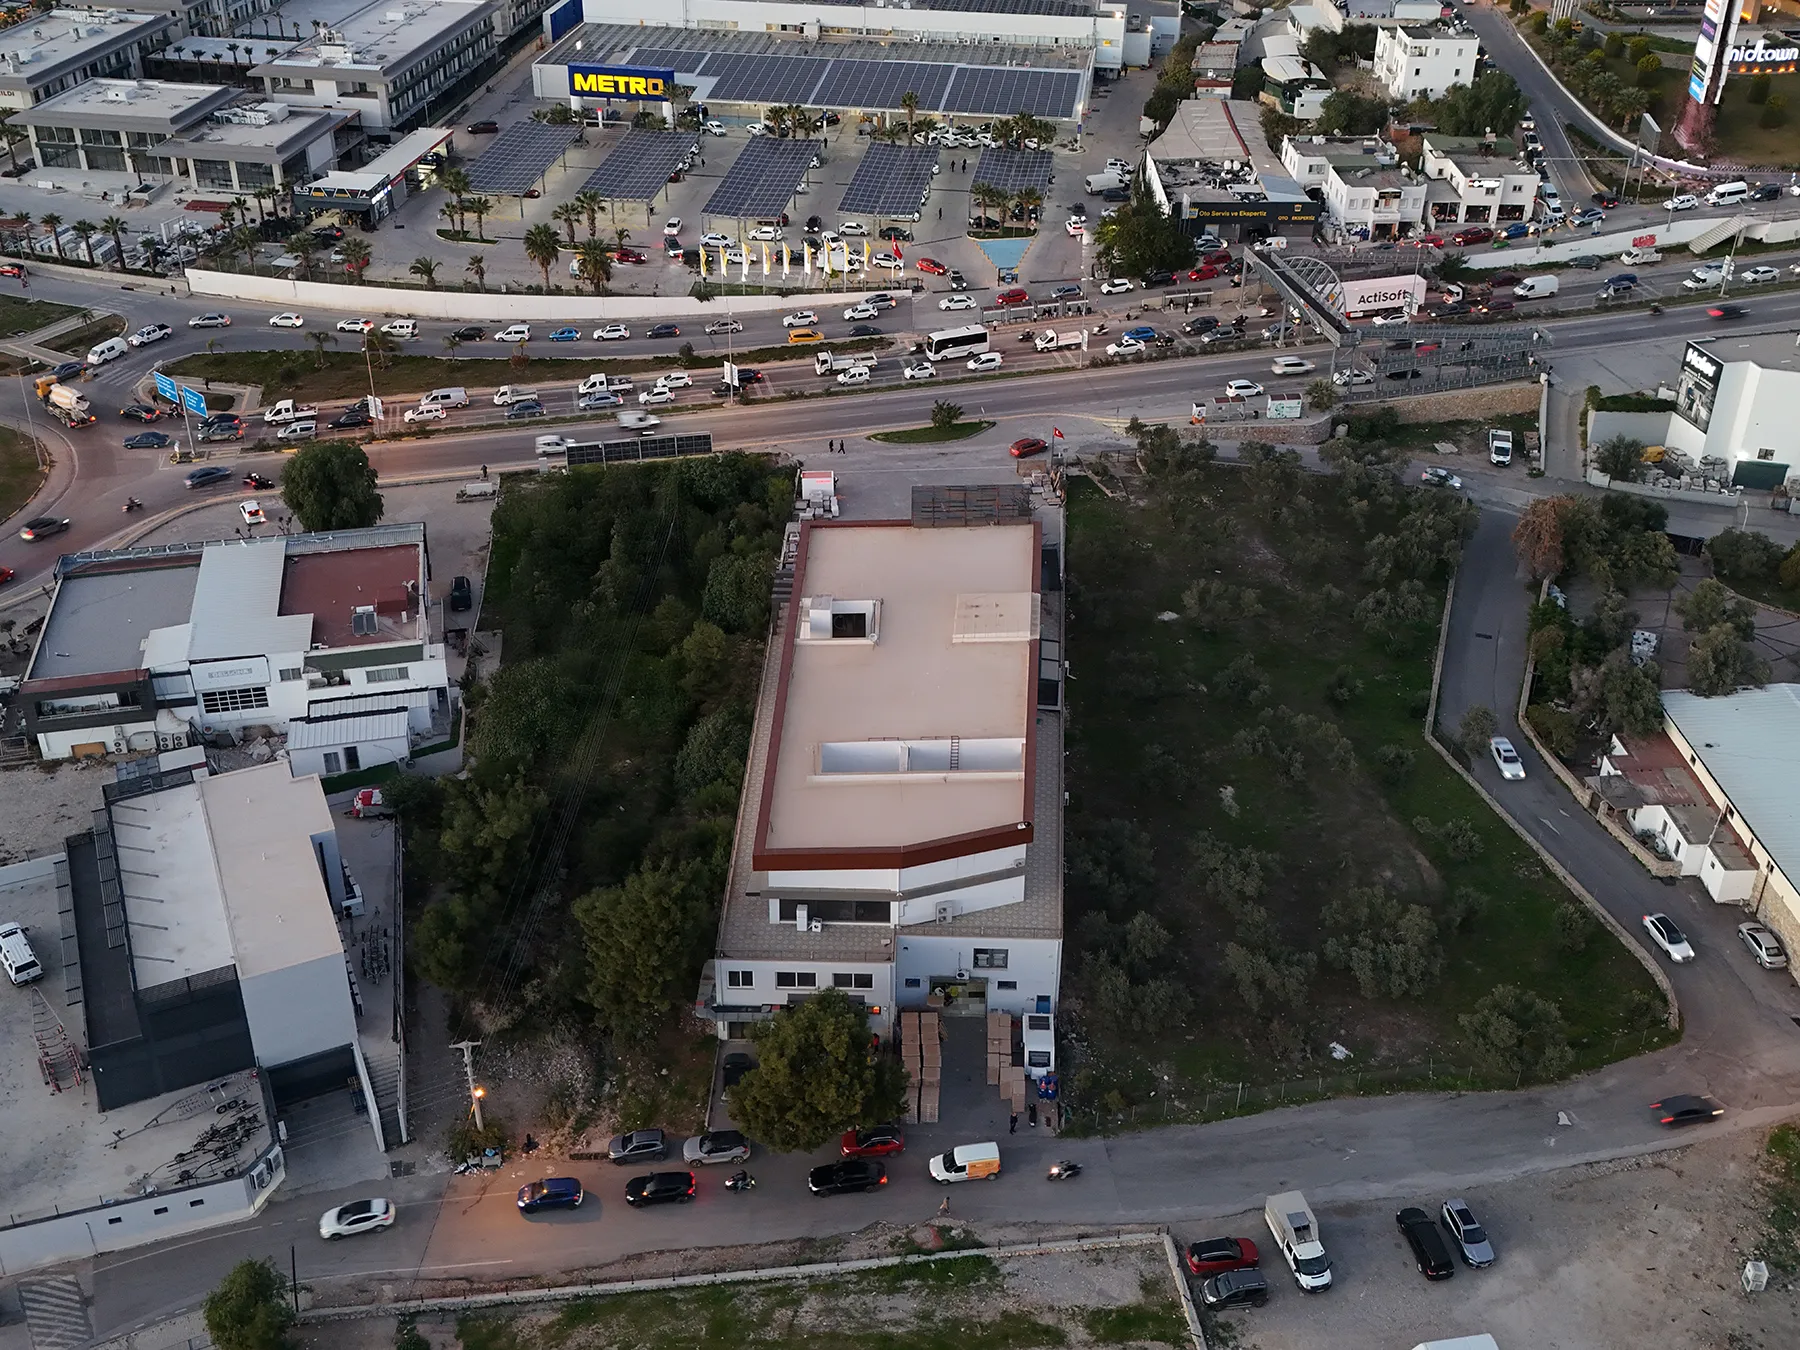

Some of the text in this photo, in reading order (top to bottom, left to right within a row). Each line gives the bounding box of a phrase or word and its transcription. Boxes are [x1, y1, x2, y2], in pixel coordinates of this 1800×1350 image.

[574, 73, 664, 95] METRO
[1239, 210, 1267, 218] Ekspertiz
[1358, 289, 1408, 304] ActiSoft
